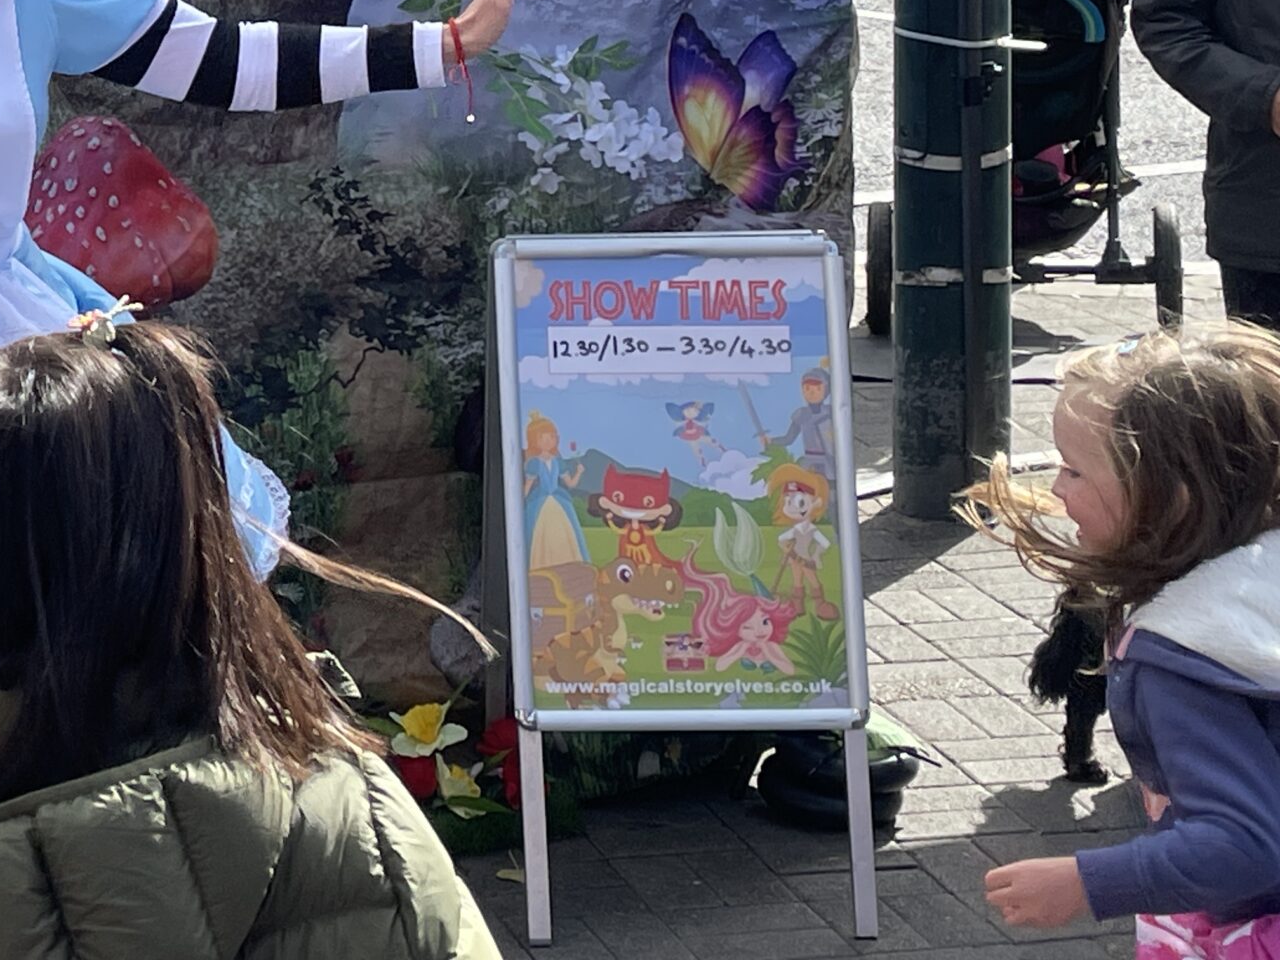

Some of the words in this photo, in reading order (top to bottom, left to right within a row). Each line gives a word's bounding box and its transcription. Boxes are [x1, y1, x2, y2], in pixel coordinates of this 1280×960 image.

[548, 279, 660, 321] SHOW
[668, 279, 788, 321] TIMES
[545, 678, 833, 697] www.magicalstoryelves.co.uk
